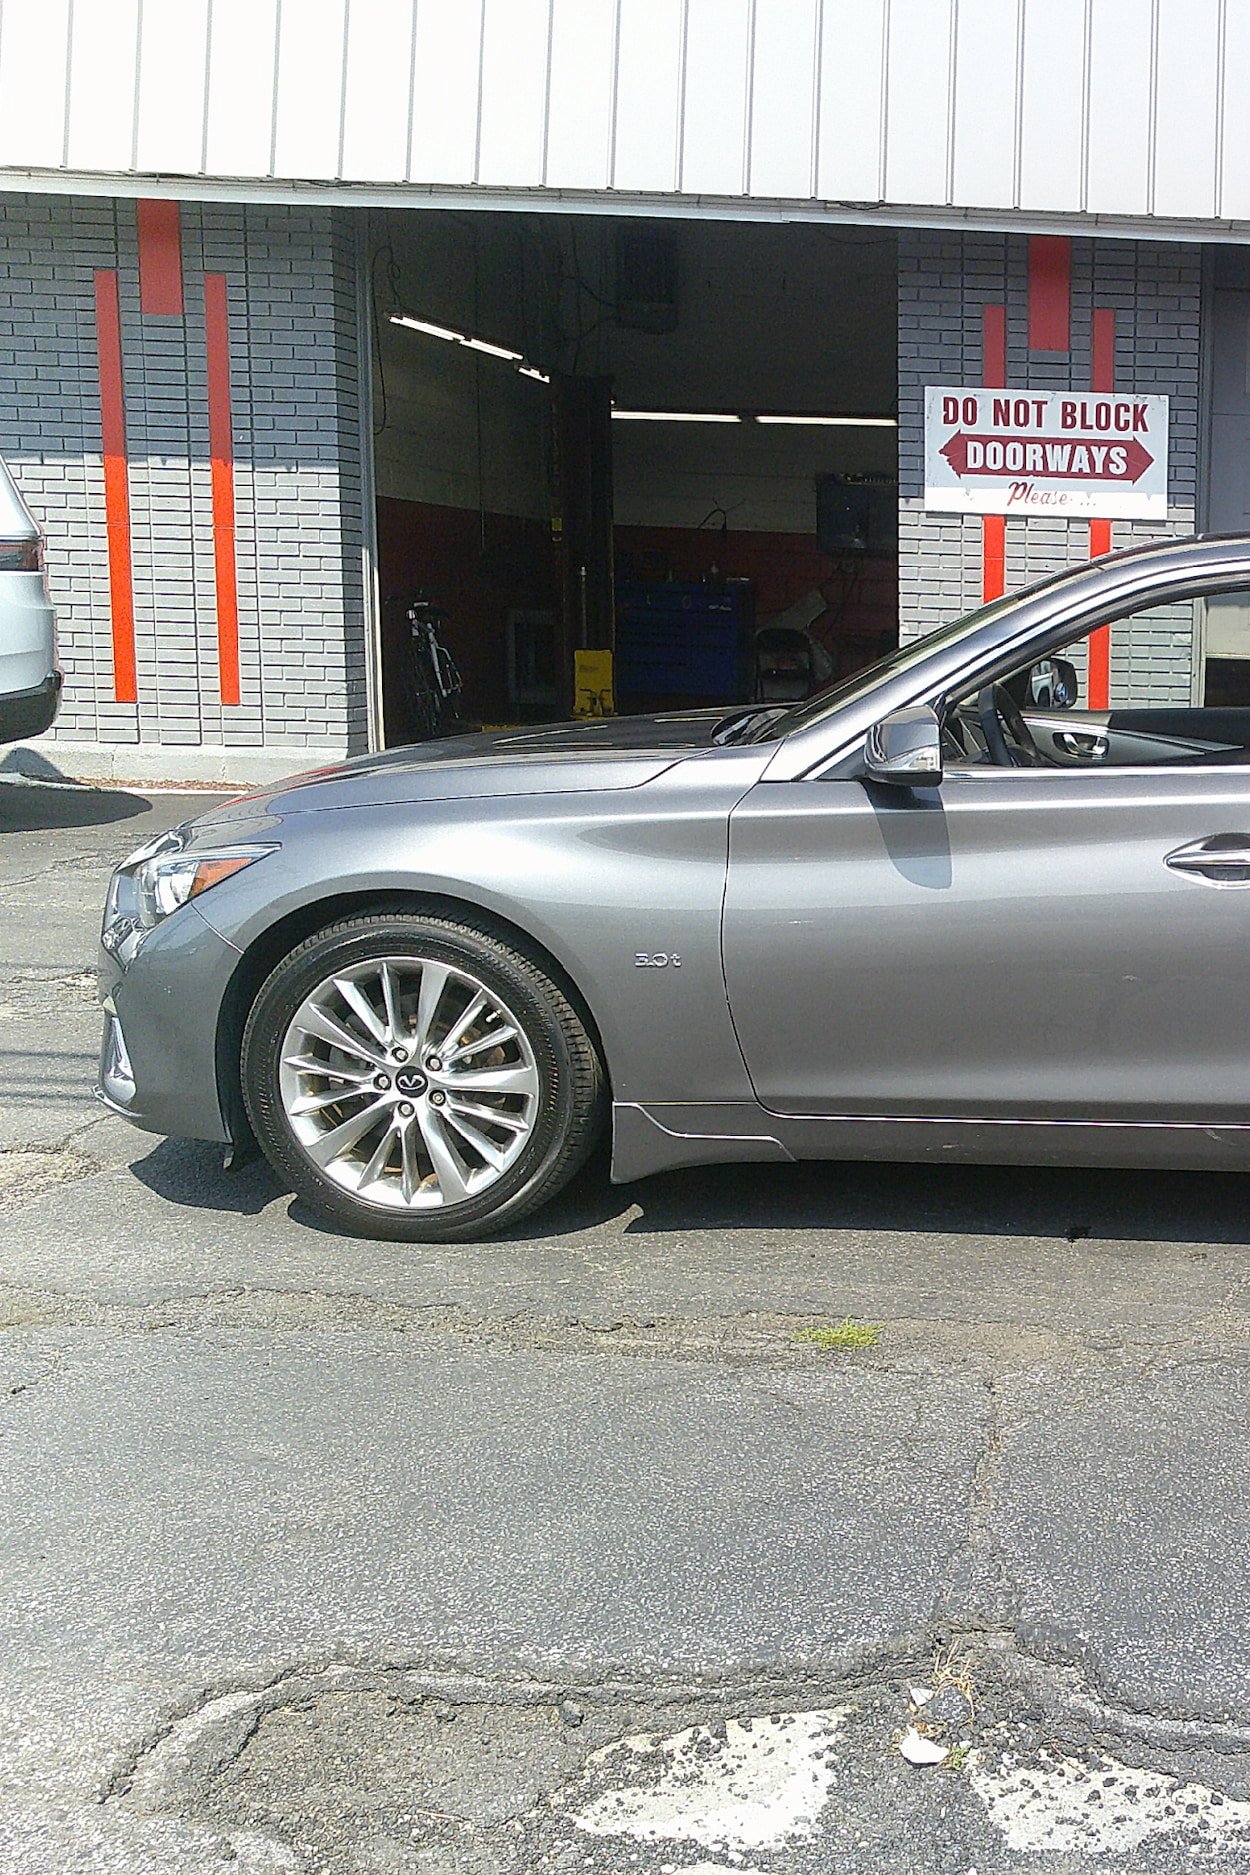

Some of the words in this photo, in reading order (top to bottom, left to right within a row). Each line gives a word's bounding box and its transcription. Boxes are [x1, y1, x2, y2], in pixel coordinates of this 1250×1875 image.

[943, 396, 977, 426] DO
[993, 399, 1048, 428] NOT
[1061, 401, 1149, 432] BLOCK
[966, 440, 1128, 475] DOORWAYS
[1006, 481, 1068, 507] Please
